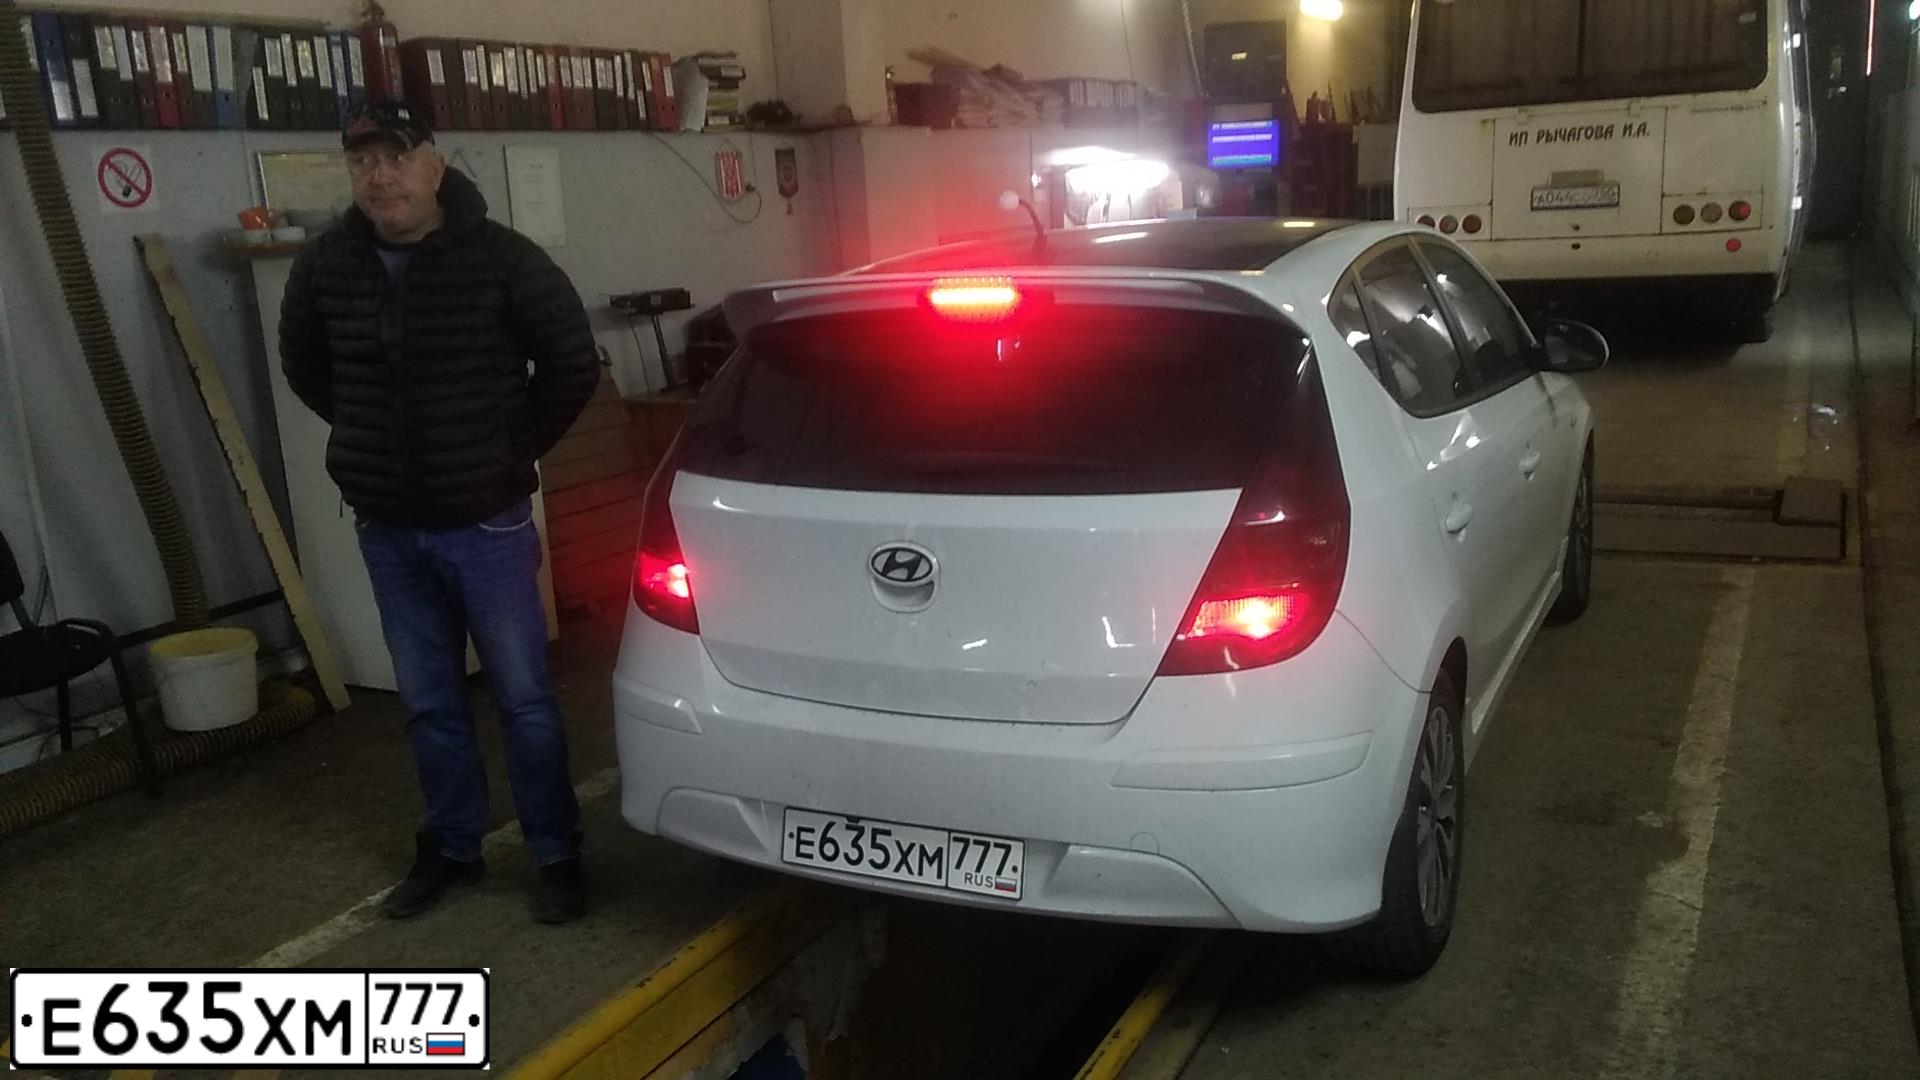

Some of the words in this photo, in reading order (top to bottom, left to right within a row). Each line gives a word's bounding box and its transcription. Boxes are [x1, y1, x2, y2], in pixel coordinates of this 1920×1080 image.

[1508, 130, 1529, 147] ИП
[1536, 123, 1615, 145] РЫЧАГОВА
[1622, 121, 1650, 139] И.А.
[795, 821, 943, 880] Е635ХМ
[952, 836, 1012, 876] 777
[964, 872, 993, 889] RUS
